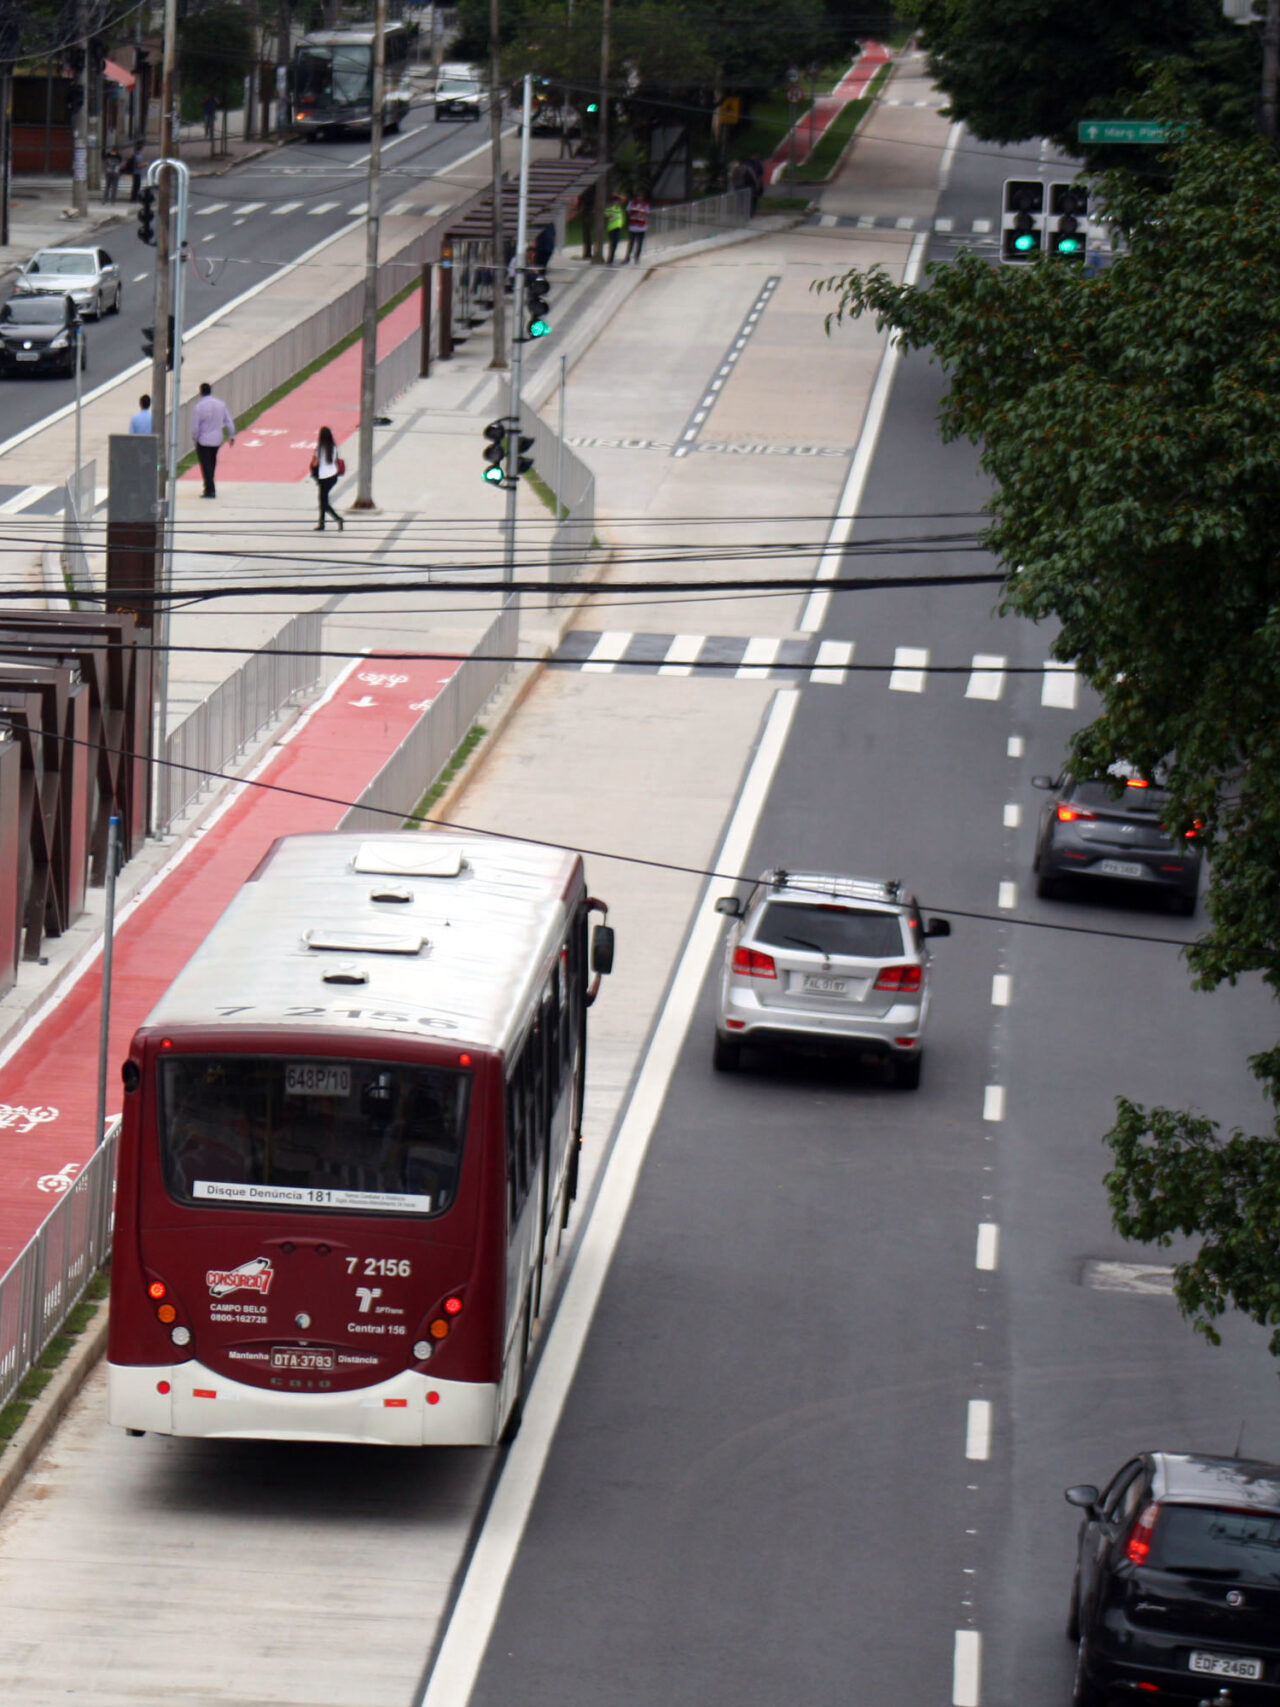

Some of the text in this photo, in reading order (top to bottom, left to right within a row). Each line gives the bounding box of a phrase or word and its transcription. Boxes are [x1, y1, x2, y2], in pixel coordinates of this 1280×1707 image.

[216, 1006, 459, 1030] 7 2156
[286, 1068, 350, 1091] 648P/10
[207, 1185, 246, 1197] Disque
[249, 1187, 302, 1200] Denúncia
[307, 1190, 332, 1202] 181
[345, 1257, 411, 1277] 7 2156
[209, 1303, 267, 1313] CAMPO BELO
[210, 1313, 268, 1323] 0800-162728
[347, 1322, 406, 1335] Central 156
[228, 1351, 270, 1360] Mantenha
[337, 1354, 379, 1364] Distância
